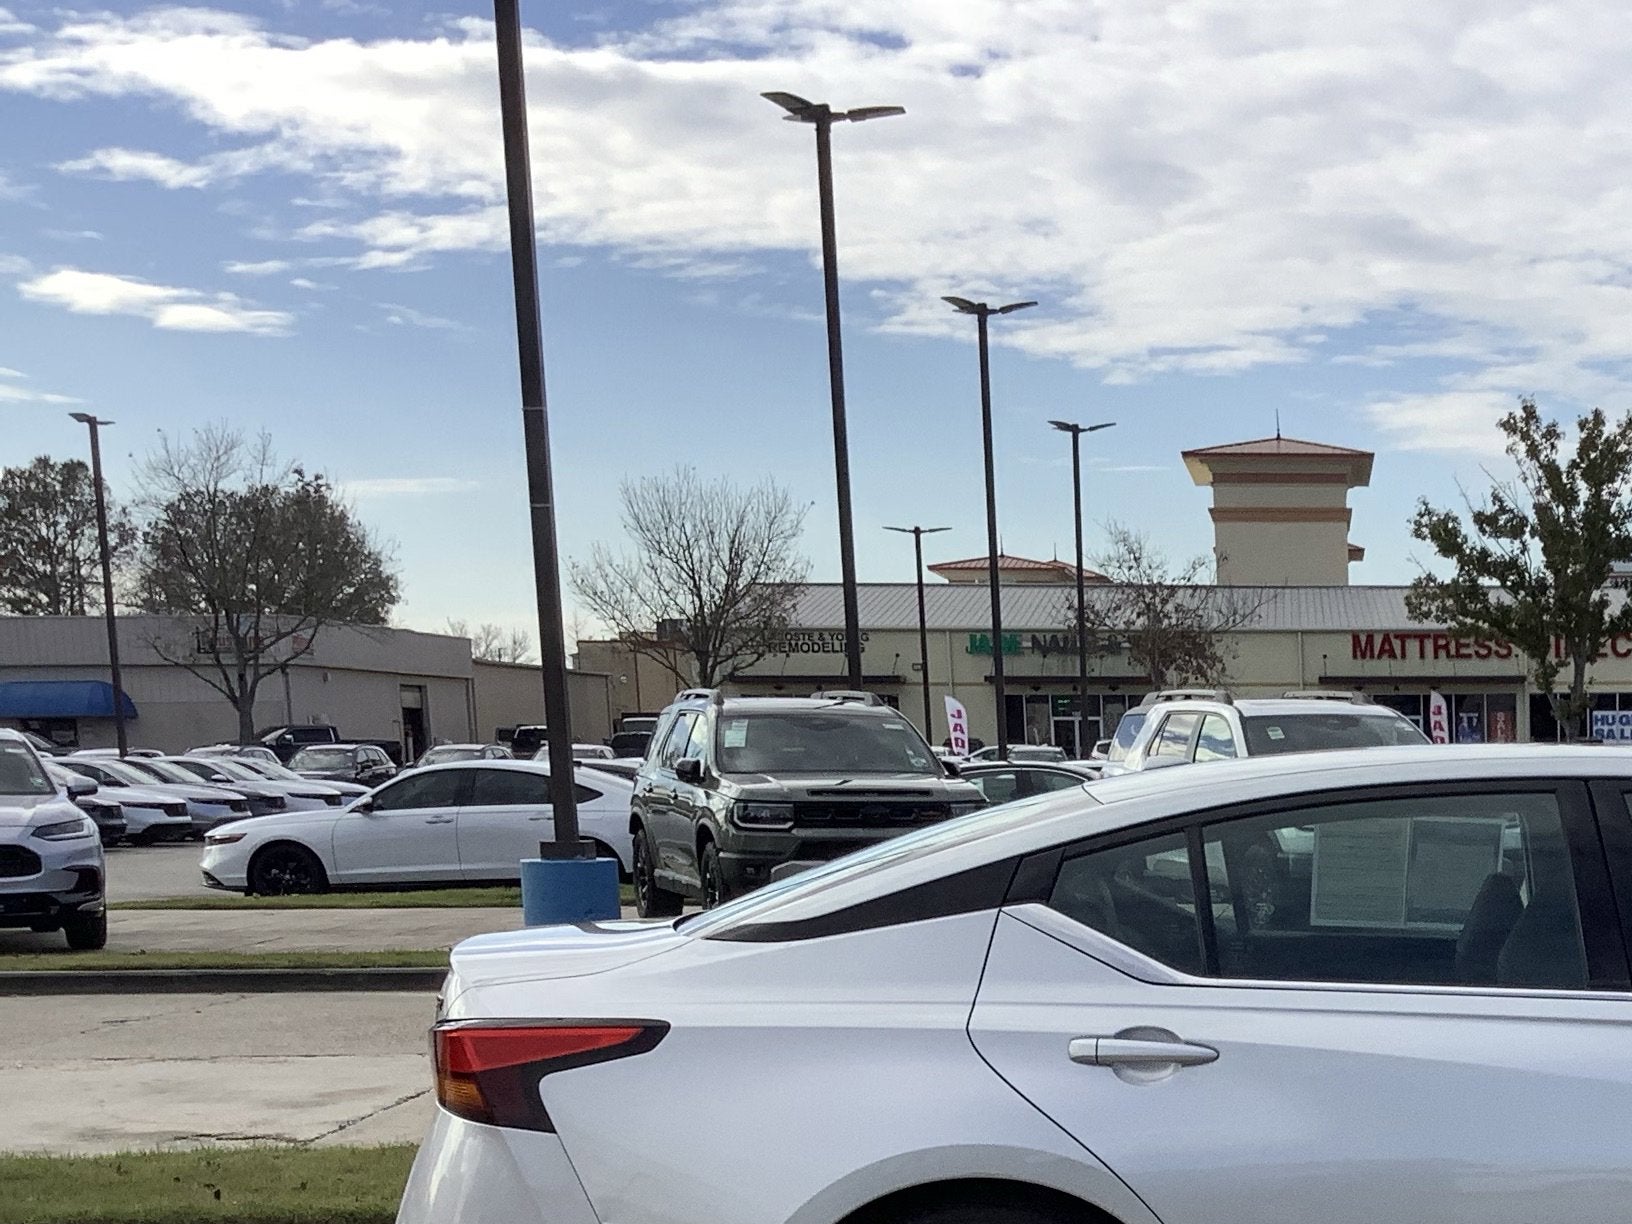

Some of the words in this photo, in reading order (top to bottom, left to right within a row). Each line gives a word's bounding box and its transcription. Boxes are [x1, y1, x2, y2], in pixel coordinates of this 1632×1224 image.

[768, 642, 866, 653] REMODELIG
[818, 632, 826, 642] &
[828, 632, 870, 642] YOG
[1031, 634, 1090, 656] NAIL
[1351, 633, 1513, 660] MATTRESS
[950, 708, 966, 755] JAD
